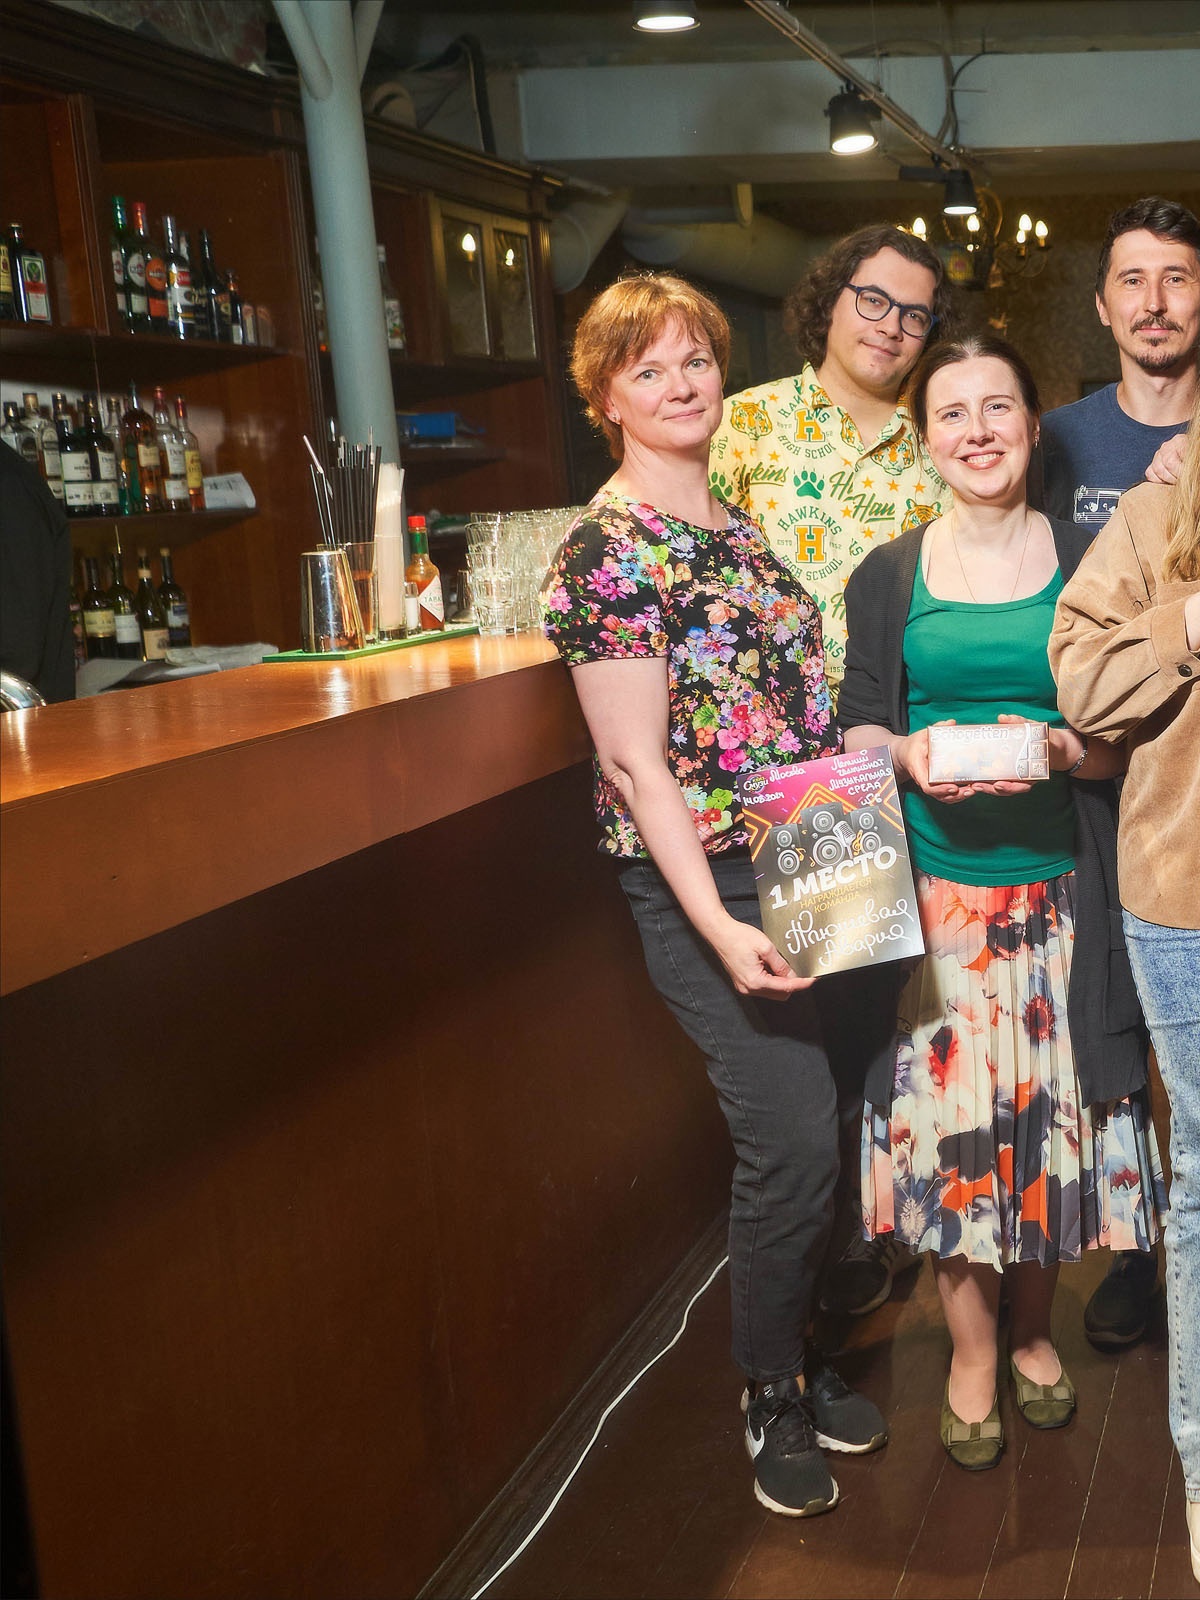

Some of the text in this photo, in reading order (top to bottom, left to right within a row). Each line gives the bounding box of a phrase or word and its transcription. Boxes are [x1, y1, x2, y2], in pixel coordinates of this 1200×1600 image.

[777, 505, 842, 535] HAWKINS
[780, 554, 843, 581] HIGH SCHOOL
[847, 781, 882, 796] СРЕДА
[769, 845, 897, 910] 1 МЕСТО
[799, 877, 873, 909] НАГРАЖДАЕТСЯ
[814, 891, 861, 914] КОМАНДА
[818, 923, 912, 968] Авария
